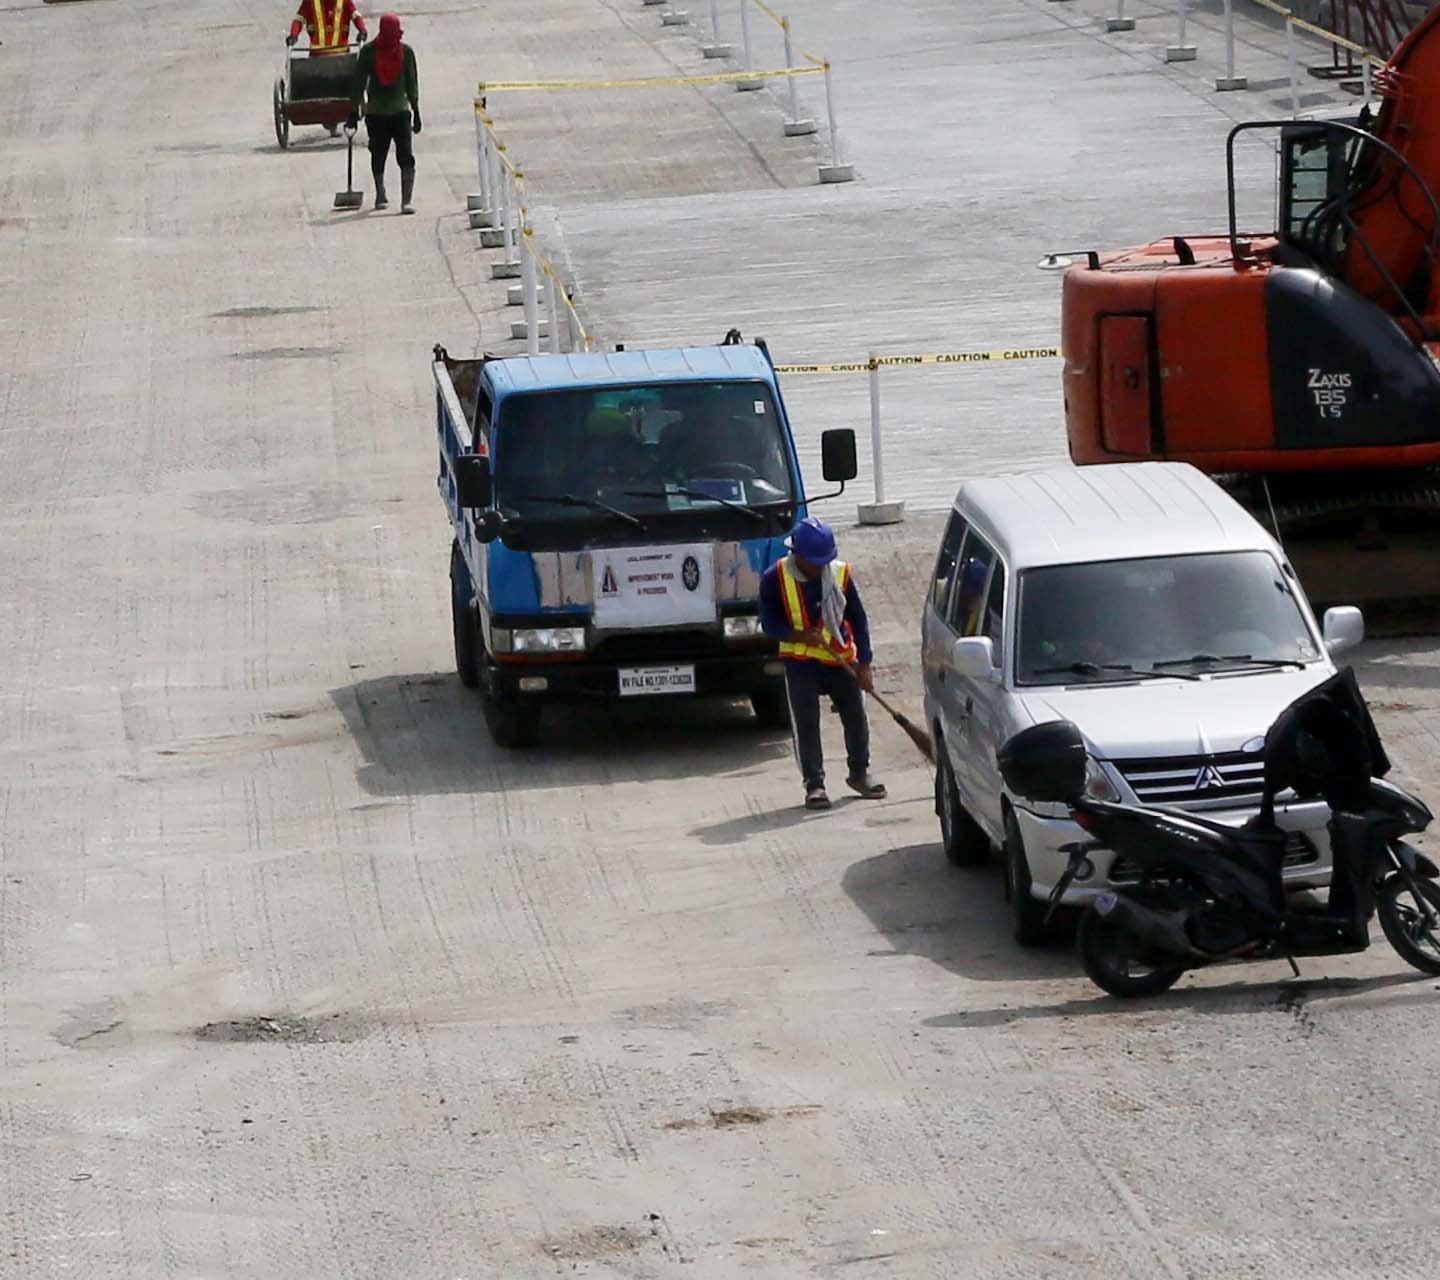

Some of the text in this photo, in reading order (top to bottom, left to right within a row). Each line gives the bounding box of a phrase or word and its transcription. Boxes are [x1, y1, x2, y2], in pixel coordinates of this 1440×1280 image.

[936, 353, 989, 362] CAUTION
[1003, 350, 1057, 360] CAUTION
[1313, 389, 1346, 405] 135
